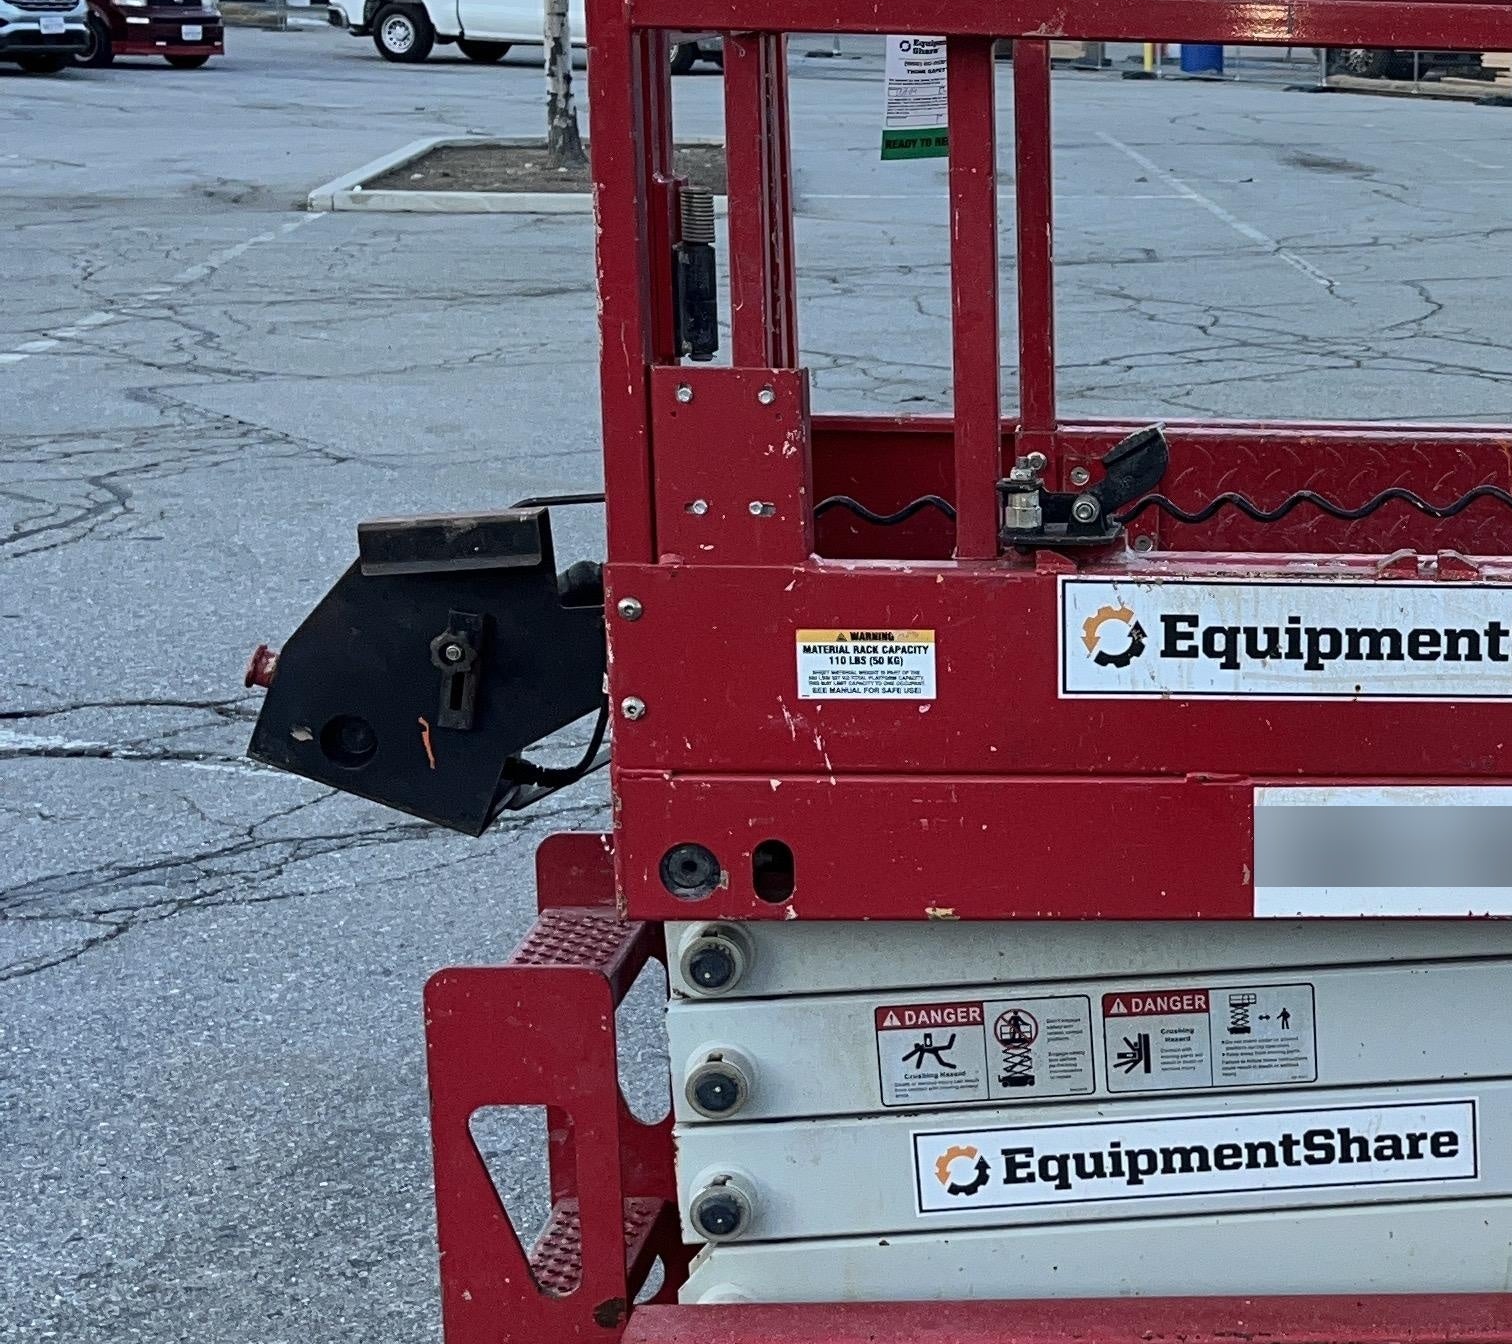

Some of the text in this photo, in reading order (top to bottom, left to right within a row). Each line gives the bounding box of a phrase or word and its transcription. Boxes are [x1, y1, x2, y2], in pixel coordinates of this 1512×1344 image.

[885, 138, 918, 150] READY
[920, 138, 933, 148] TO
[849, 631, 895, 642] WARNING
[803, 645, 929, 655] MATERIAL RACK CAPACITY
[829, 656, 904, 667] 110 LBS (50 KG)
[1131, 994, 1207, 1013] DANGER
[904, 1007, 981, 1025] DANGER
[904, 1070, 966, 1080] Crushing Hazard
[1001, 1127, 1460, 1191] EquipmentShare
